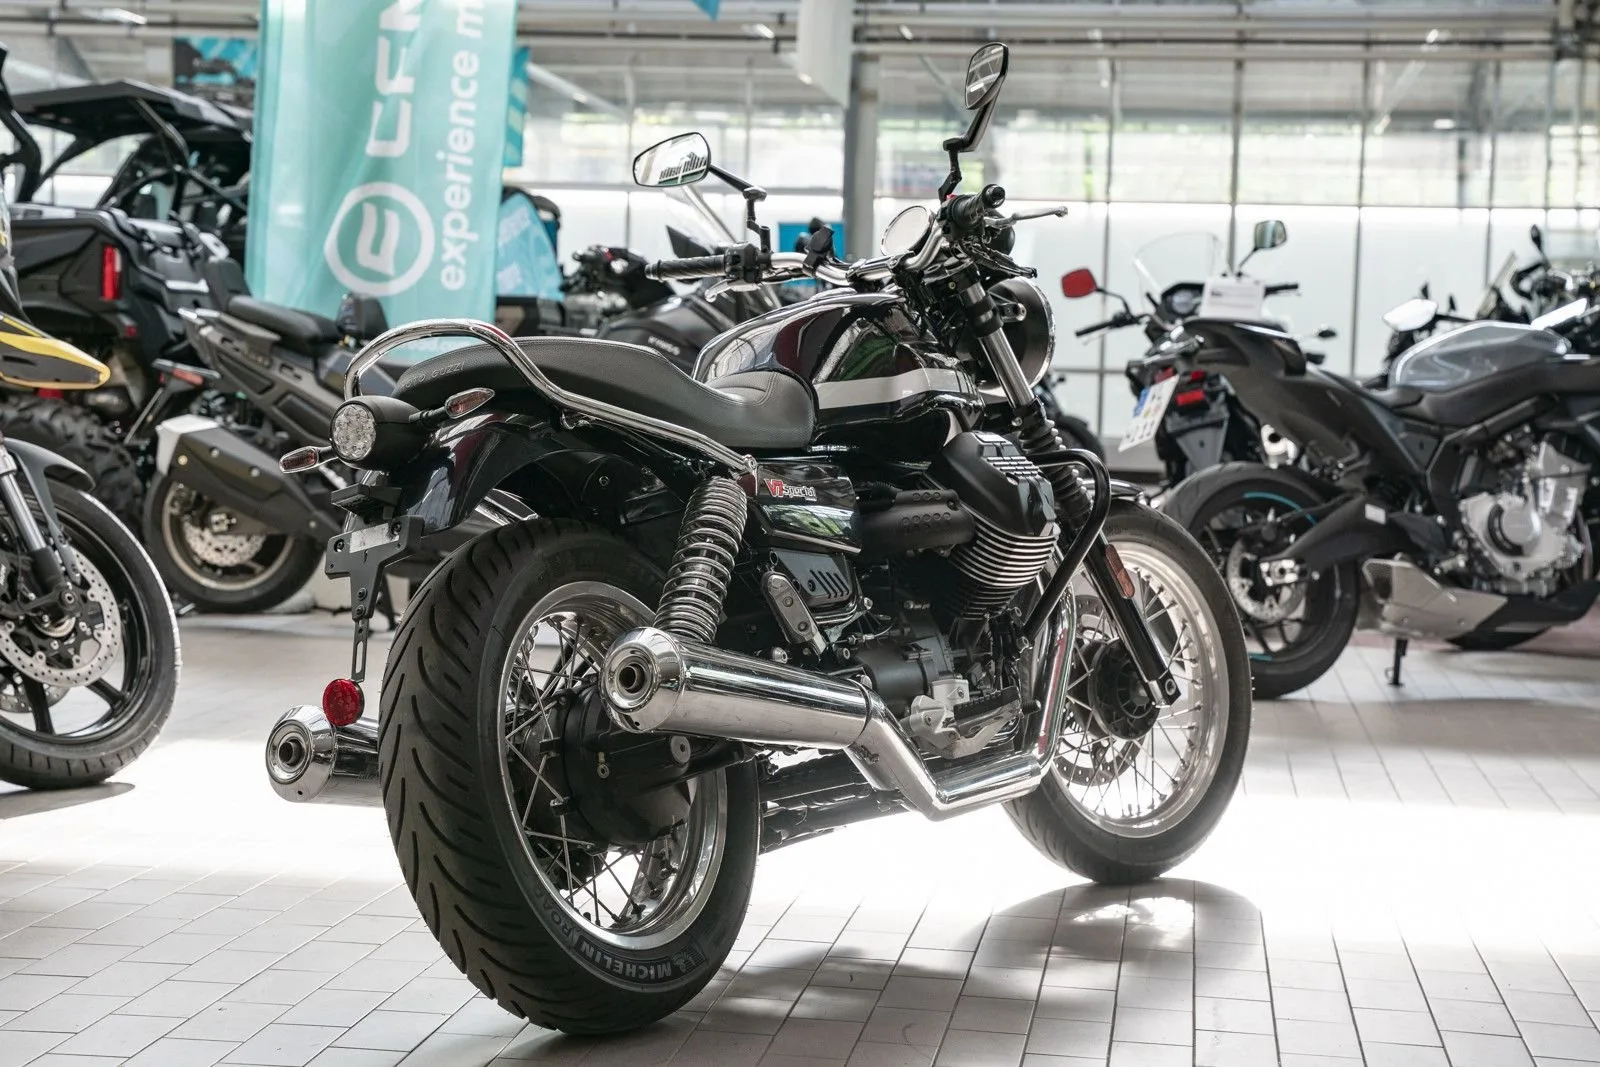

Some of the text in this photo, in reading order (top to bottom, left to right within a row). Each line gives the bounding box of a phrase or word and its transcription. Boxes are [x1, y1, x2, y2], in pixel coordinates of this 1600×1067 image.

[435, 50, 481, 291] experience
[431, 361, 466, 378] GUZZI
[581, 941, 672, 979] MICHELIN
